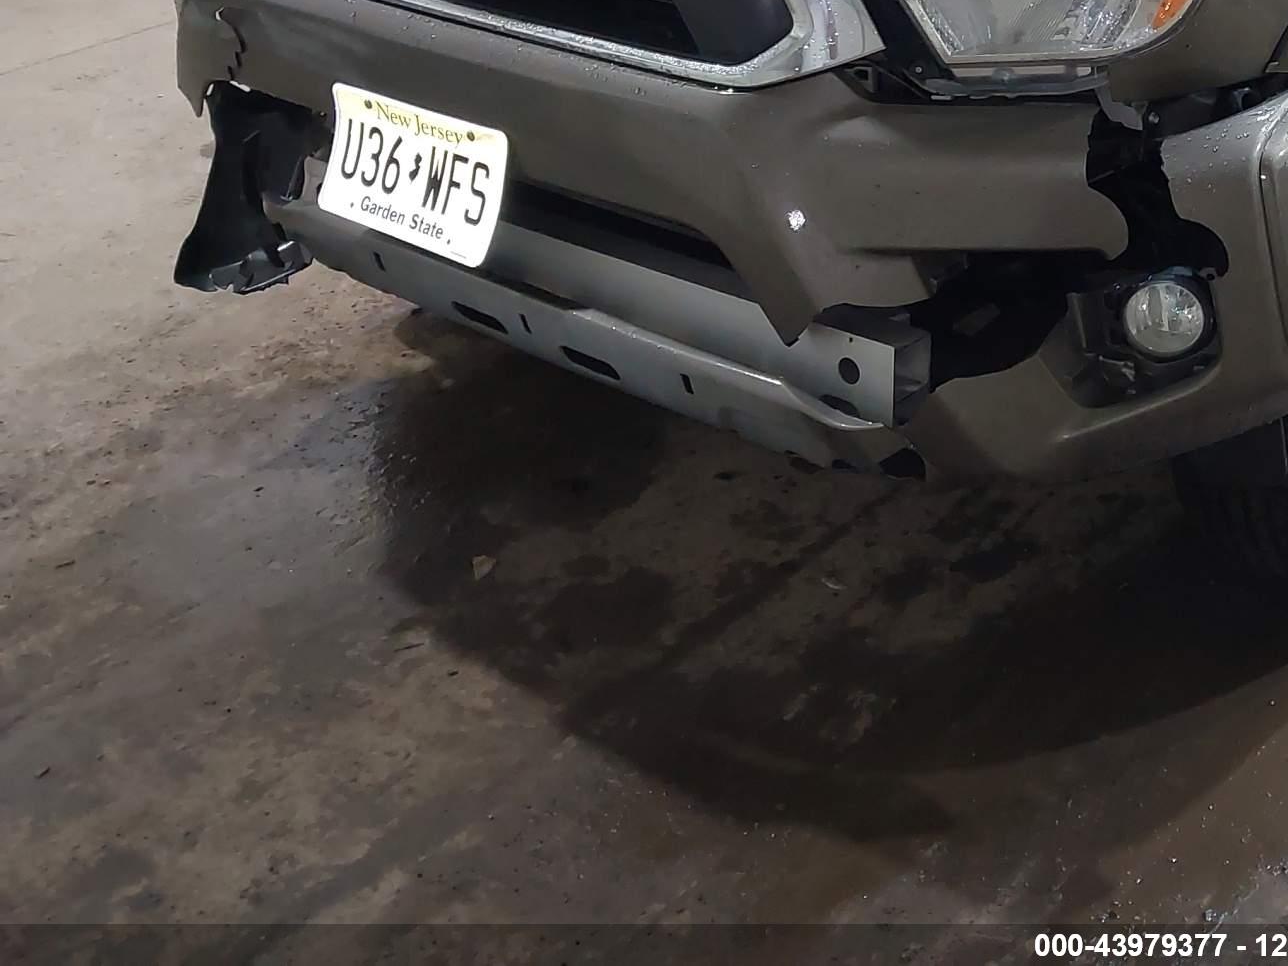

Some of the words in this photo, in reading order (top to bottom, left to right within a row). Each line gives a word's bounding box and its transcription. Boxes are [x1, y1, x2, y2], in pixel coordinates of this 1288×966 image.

[375, 100, 411, 129] New
[414, 113, 464, 146] Jersey
[341, 118, 403, 195] U36
[421, 145, 490, 226] WFS
[360, 195, 406, 226] Garden
[408, 213, 444, 240] State
